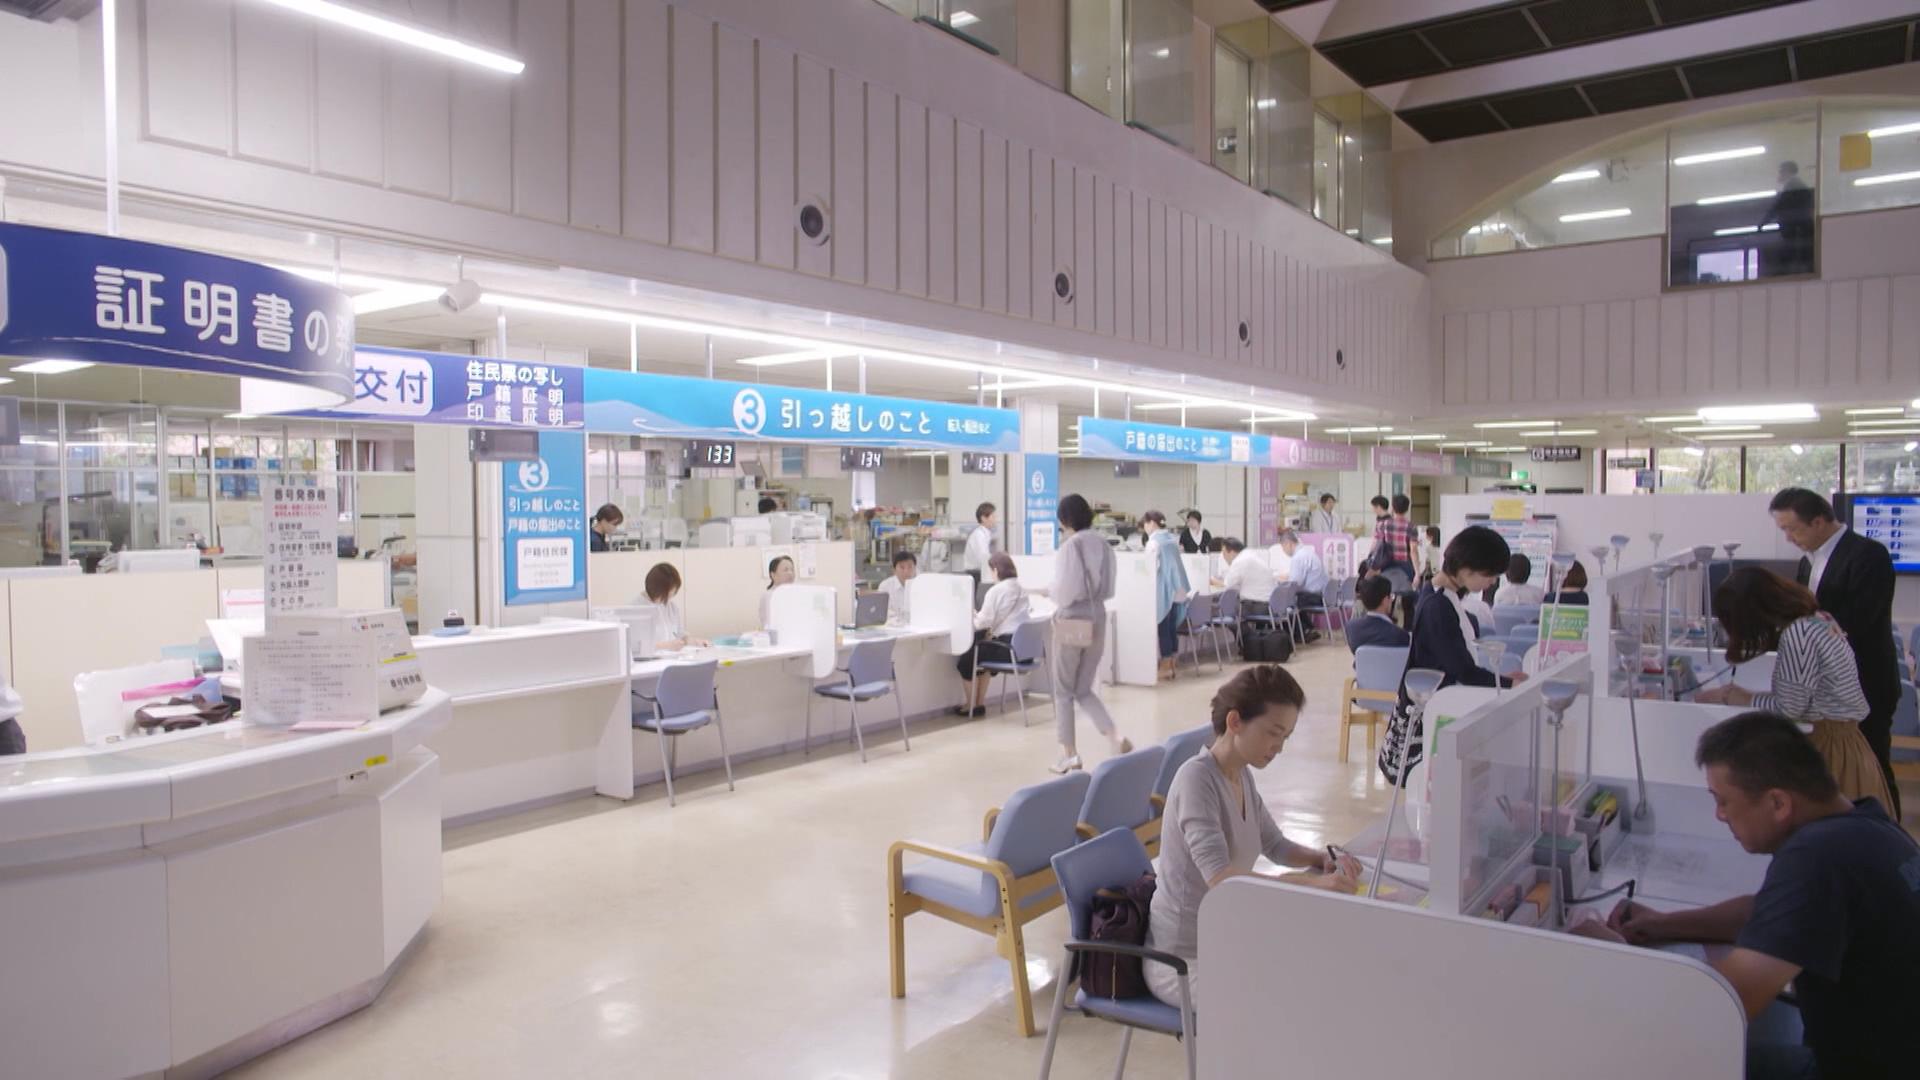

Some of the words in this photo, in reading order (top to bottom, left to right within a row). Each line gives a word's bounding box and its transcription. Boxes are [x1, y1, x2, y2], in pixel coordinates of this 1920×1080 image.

[354, 365, 428, 403] 交付
[466, 359, 563, 386] 住民票の写し
[781, 399, 931, 434] 引っ越しのこと
[708, 445, 732, 464] 133
[861, 451, 881, 467] 134
[509, 496, 580, 512] 引っ越しのこと
